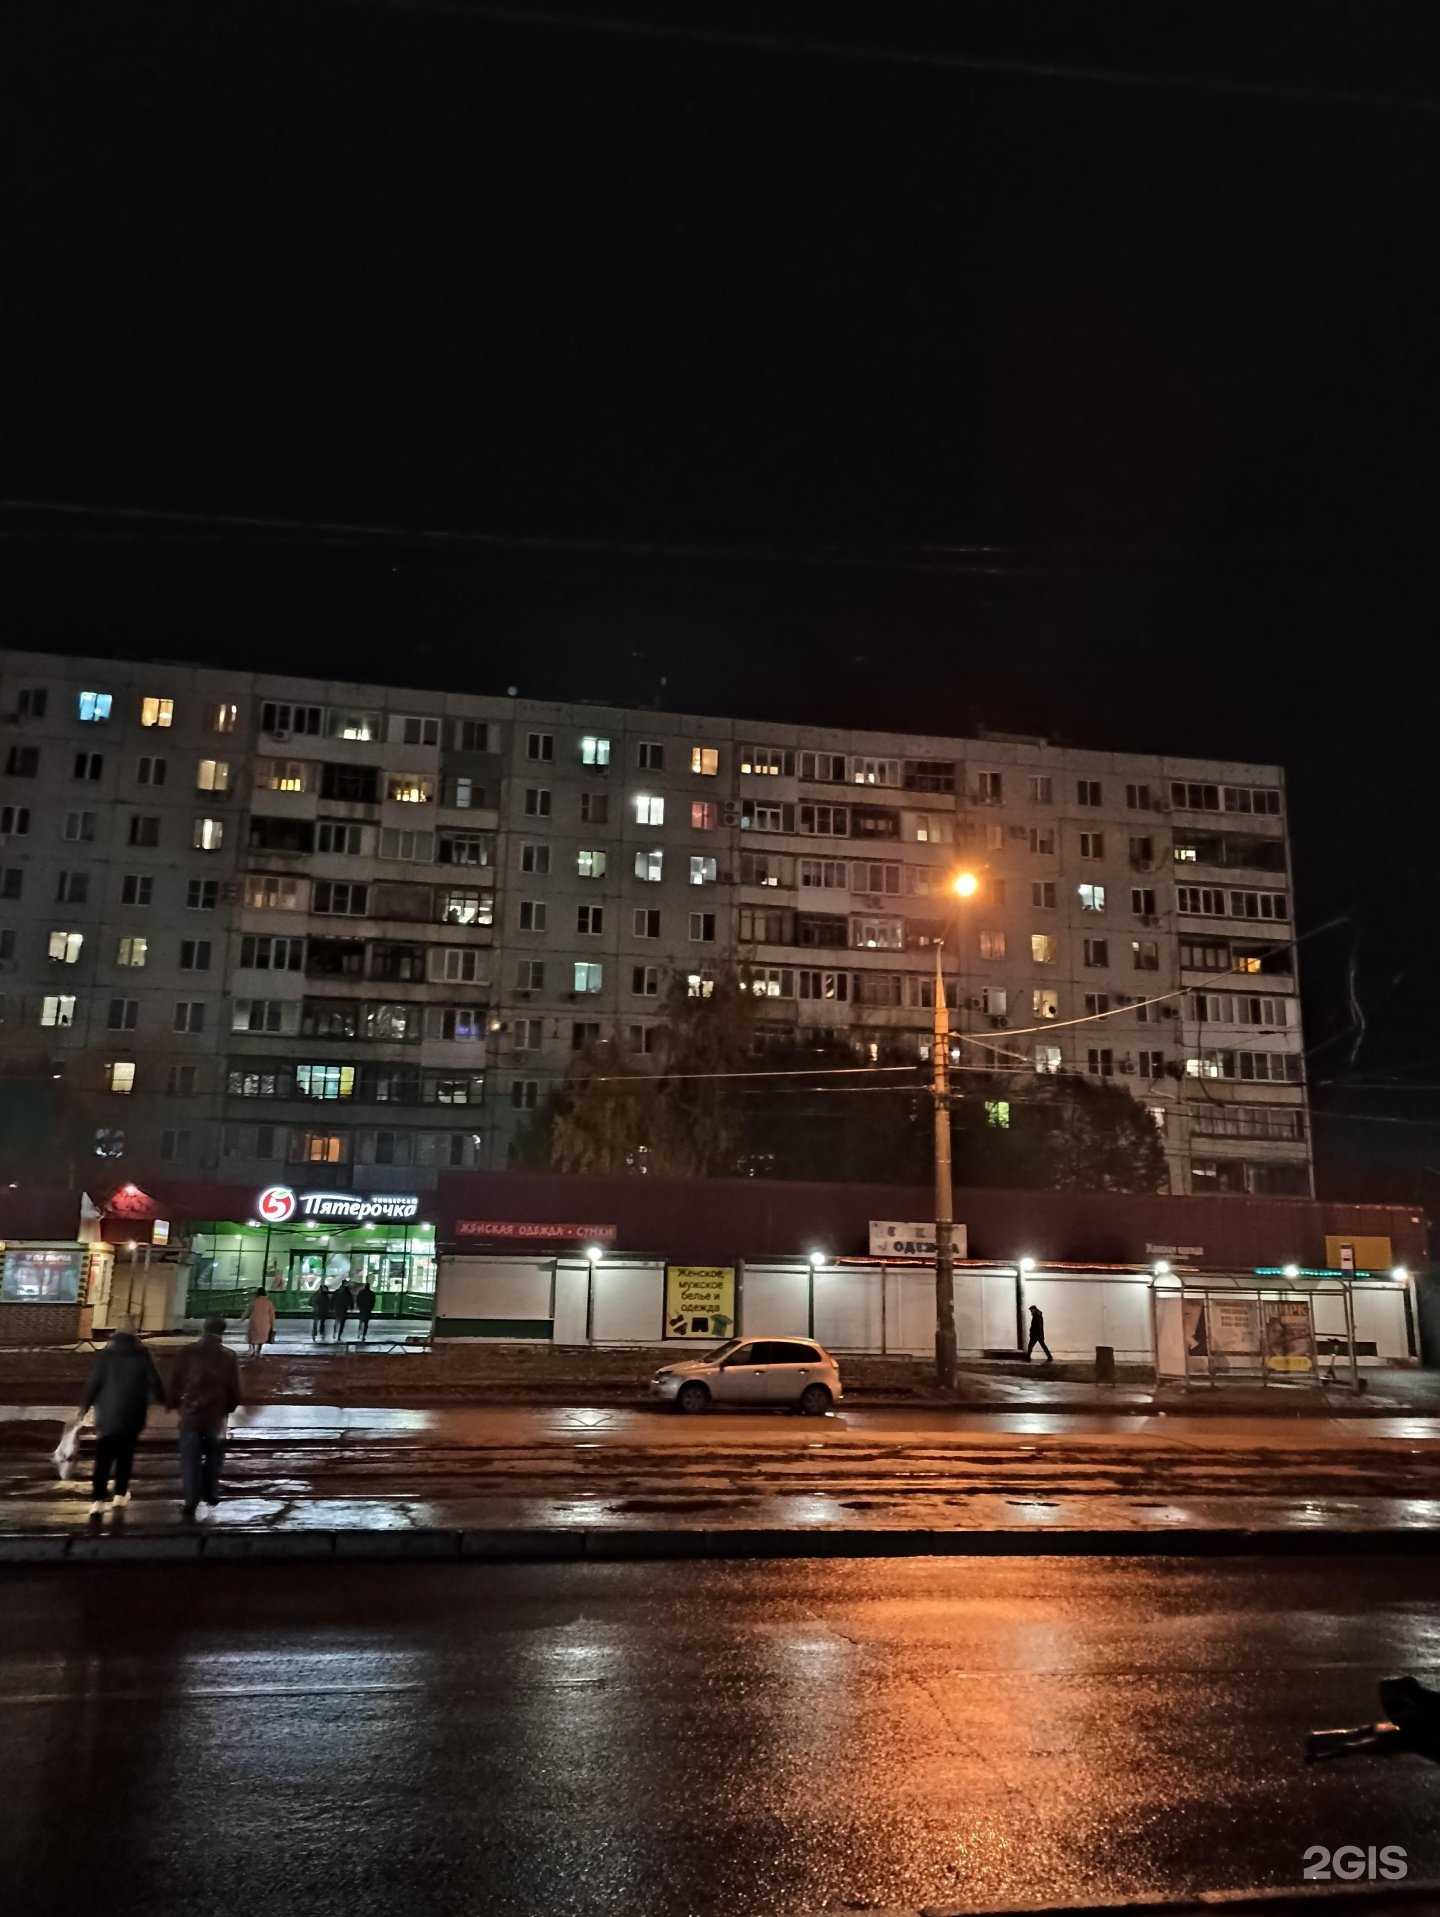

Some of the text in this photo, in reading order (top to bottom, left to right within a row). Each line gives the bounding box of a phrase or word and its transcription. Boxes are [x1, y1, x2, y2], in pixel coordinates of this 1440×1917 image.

[300, 1194, 417, 1220] Пятерочка
[460, 1223, 514, 1235] ЖЕНСКАЯ
[518, 1225, 564, 1237] ОДЕЖДА
[679, 1281, 723, 1291] мужское
[681, 1304, 720, 1313] одежда
